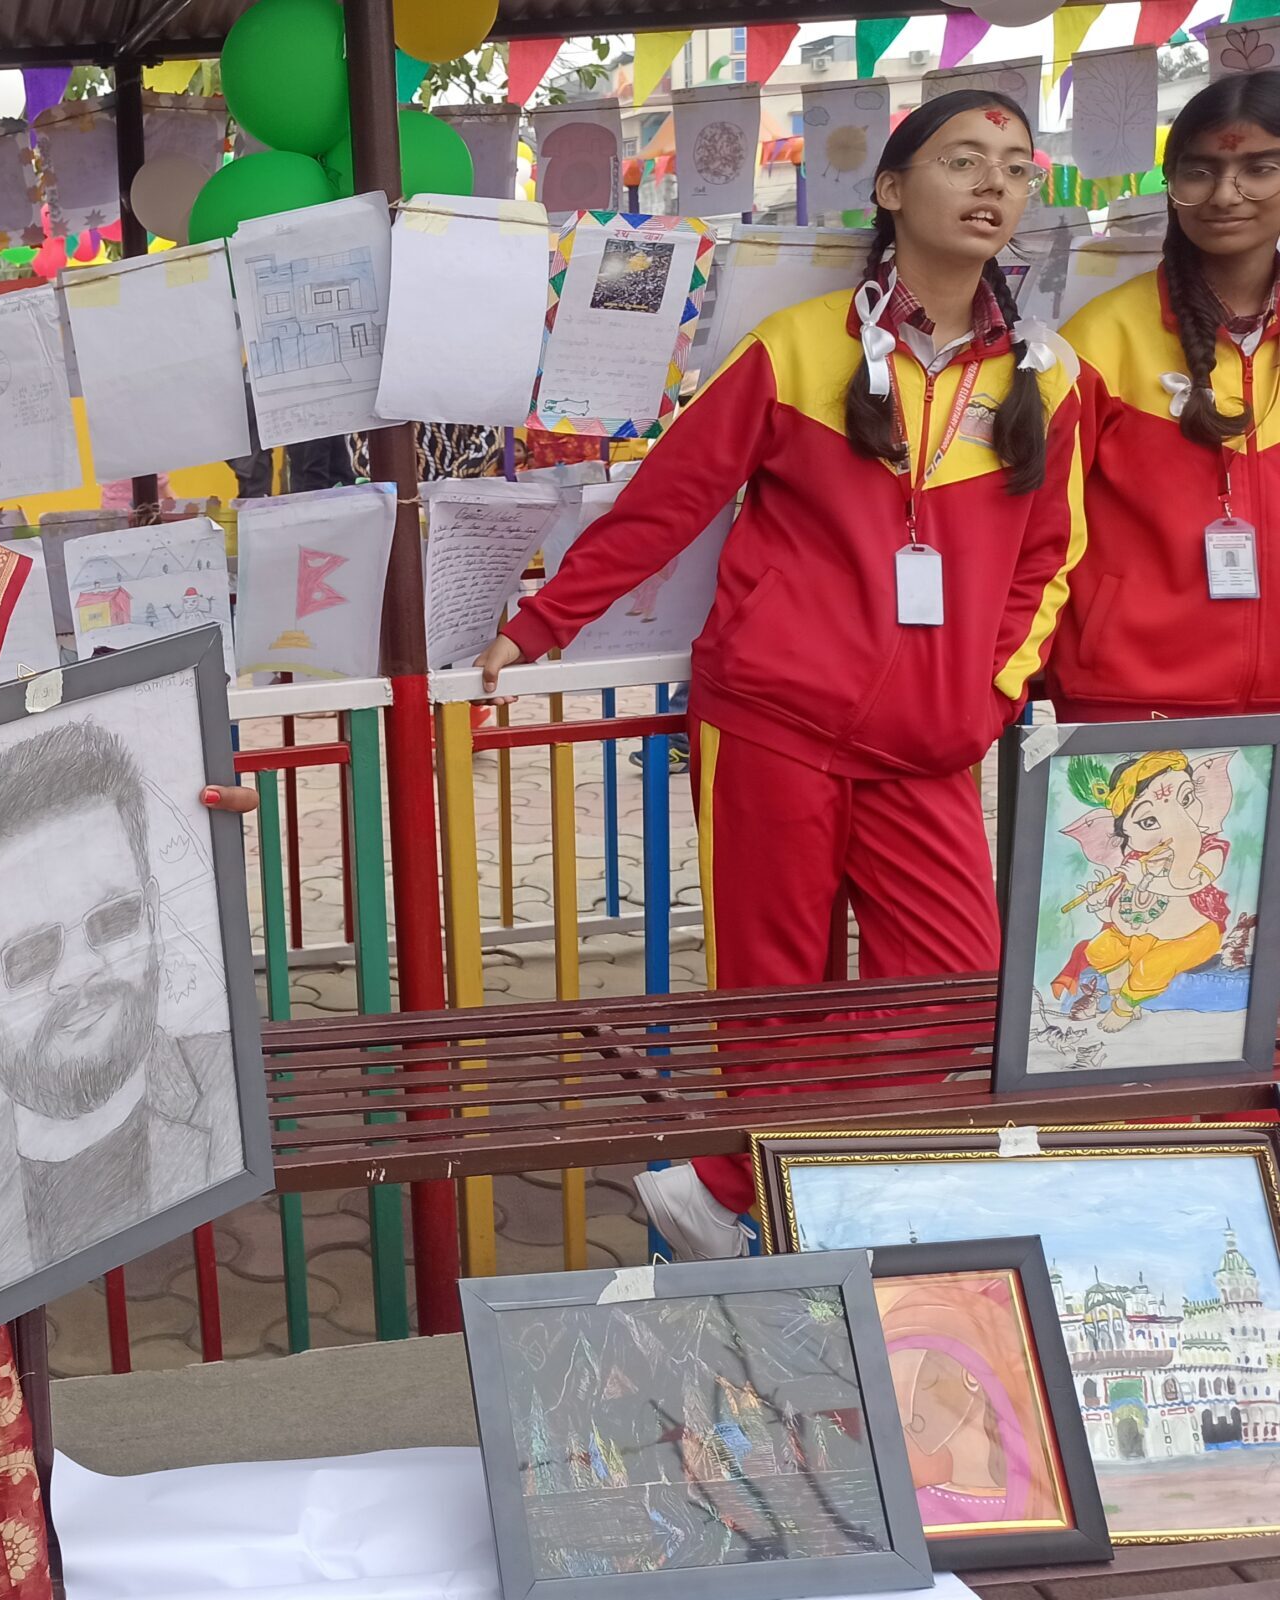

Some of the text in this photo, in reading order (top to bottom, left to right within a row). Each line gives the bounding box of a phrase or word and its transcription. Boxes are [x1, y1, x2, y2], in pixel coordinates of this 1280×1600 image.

[941, 360, 979, 451] PREMIER ELEMENTARY SCHOOL
